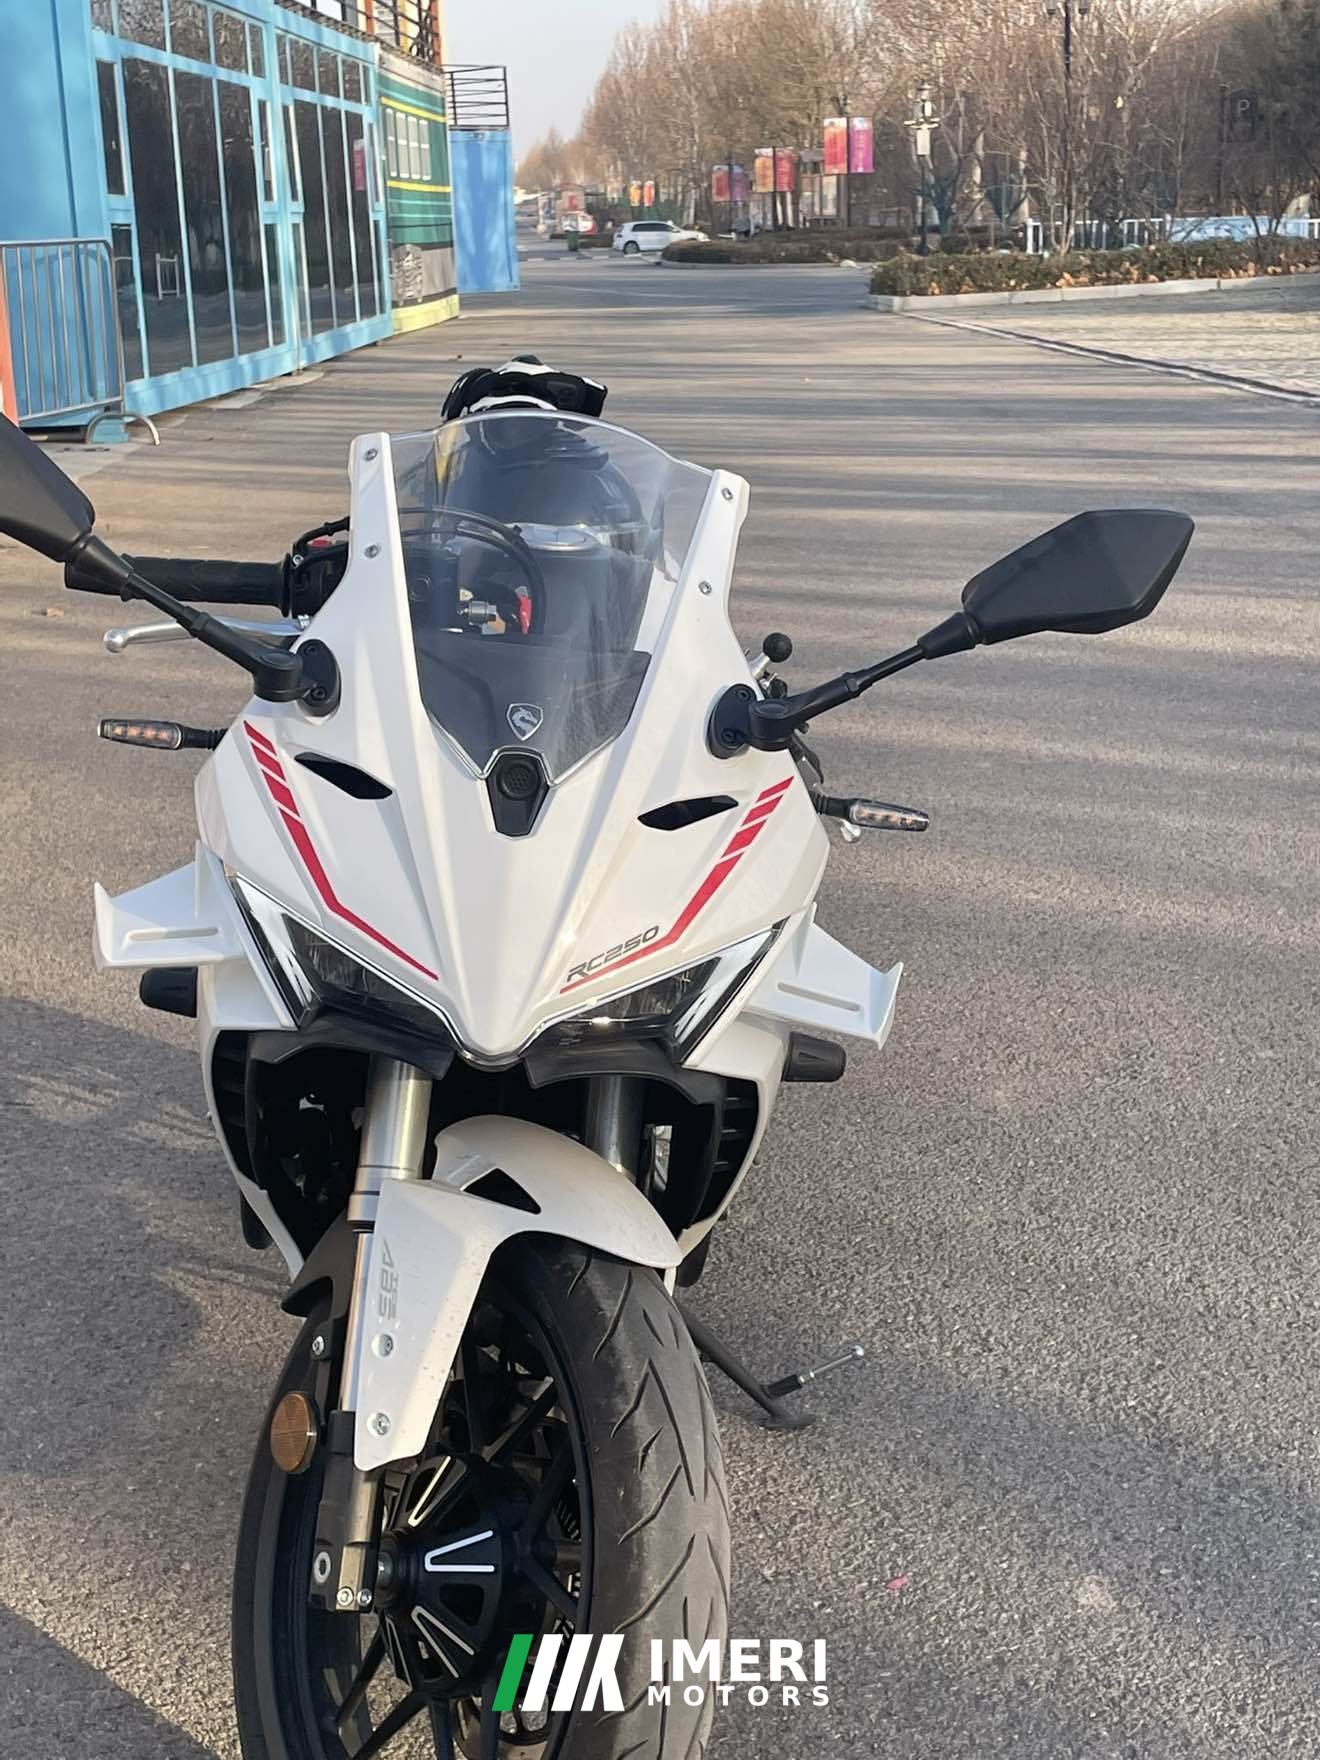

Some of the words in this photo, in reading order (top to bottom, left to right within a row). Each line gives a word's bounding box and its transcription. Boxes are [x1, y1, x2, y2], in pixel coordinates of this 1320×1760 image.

[1237, 98, 1250, 118] P
[567, 925, 659, 983] RC250
[379, 1239, 395, 1320] ABS
